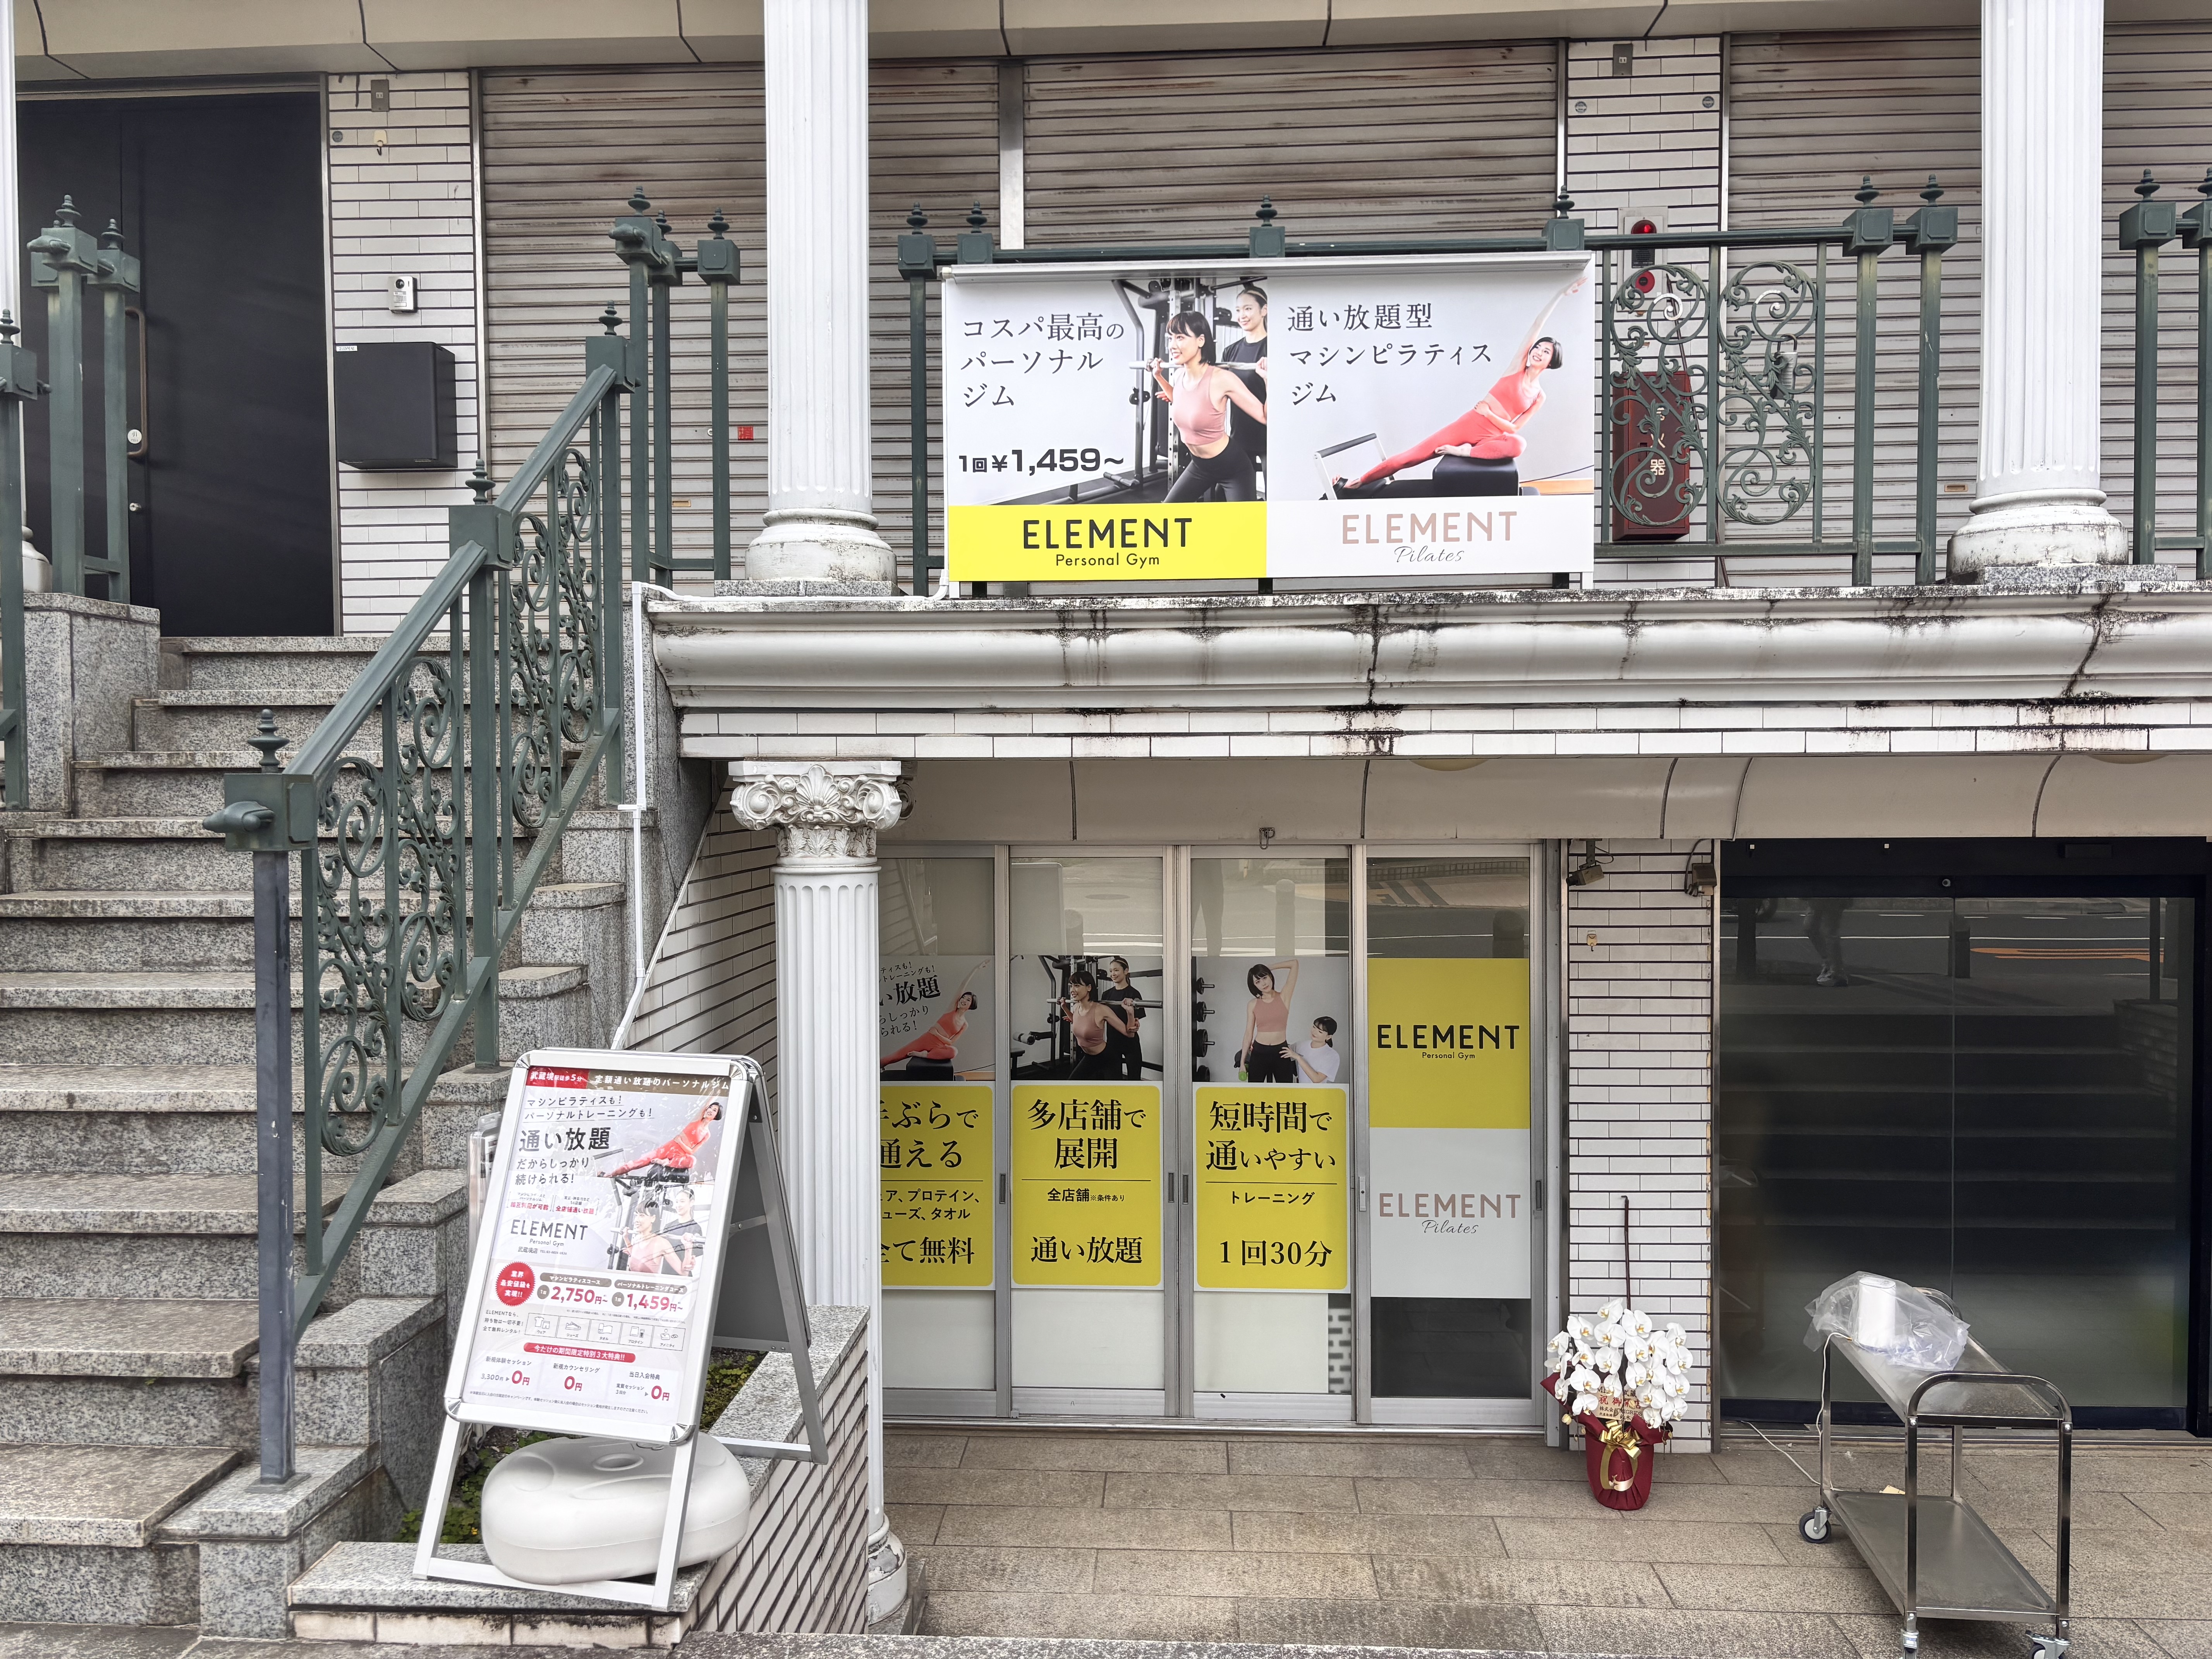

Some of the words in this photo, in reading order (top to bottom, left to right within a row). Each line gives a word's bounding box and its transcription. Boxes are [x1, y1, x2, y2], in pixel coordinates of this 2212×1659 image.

[964, 313, 1124, 341] コスパ最高の
[1288, 303, 1432, 331] 通い放題型
[961, 349, 1103, 374] パーソナル
[1290, 343, 1491, 366] マシンピラティス
[964, 383, 1014, 407] ジム
[1292, 382, 1336, 405] ジム
[1024, 518, 1192, 549] ELEMENT
[1343, 511, 1517, 544] ELEMENT
[1056, 553, 1119, 566] Personal
[1127, 553, 1159, 568] Gym
[1394, 545, 1464, 563] Pilates
[1378, 1025, 1520, 1049] ELEMENT
[1458, 1052, 1475, 1061] Gym
[527, 1096, 622, 1106] マシンピラティスも!
[525, 1108, 652, 1120] パーソナルトレーニングも!
[1027, 1099, 1146, 1130] 多店舗で
[1210, 1101, 1332, 1133] 短時間で
[519, 1127, 611, 1152] 通い放題
[517, 1157, 589, 1170] だからしっかり
[1054, 1137, 1118, 1169] 展開
[1206, 1140, 1336, 1171] 通いやすい
[515, 1173, 574, 1185] 続けられる!
[1231, 1191, 1315, 1205] トレーニング
[1379, 1193, 1521, 1218] ELEMENT
[511, 1219, 588, 1240] ELEMENT
[1422, 1220, 1479, 1234] Pilates
[1030, 1237, 1142, 1264] 通い放題
[486, 1356, 532, 1365] 新規体験セッション
[553, 1363, 600, 1373] 新規カウンセリング
[512, 1370, 530, 1386] 0円
[564, 1376, 582, 1391] 0円
[629, 1371, 660, 1380] 当日入会特典
[651, 1386, 670, 1401] 0円
